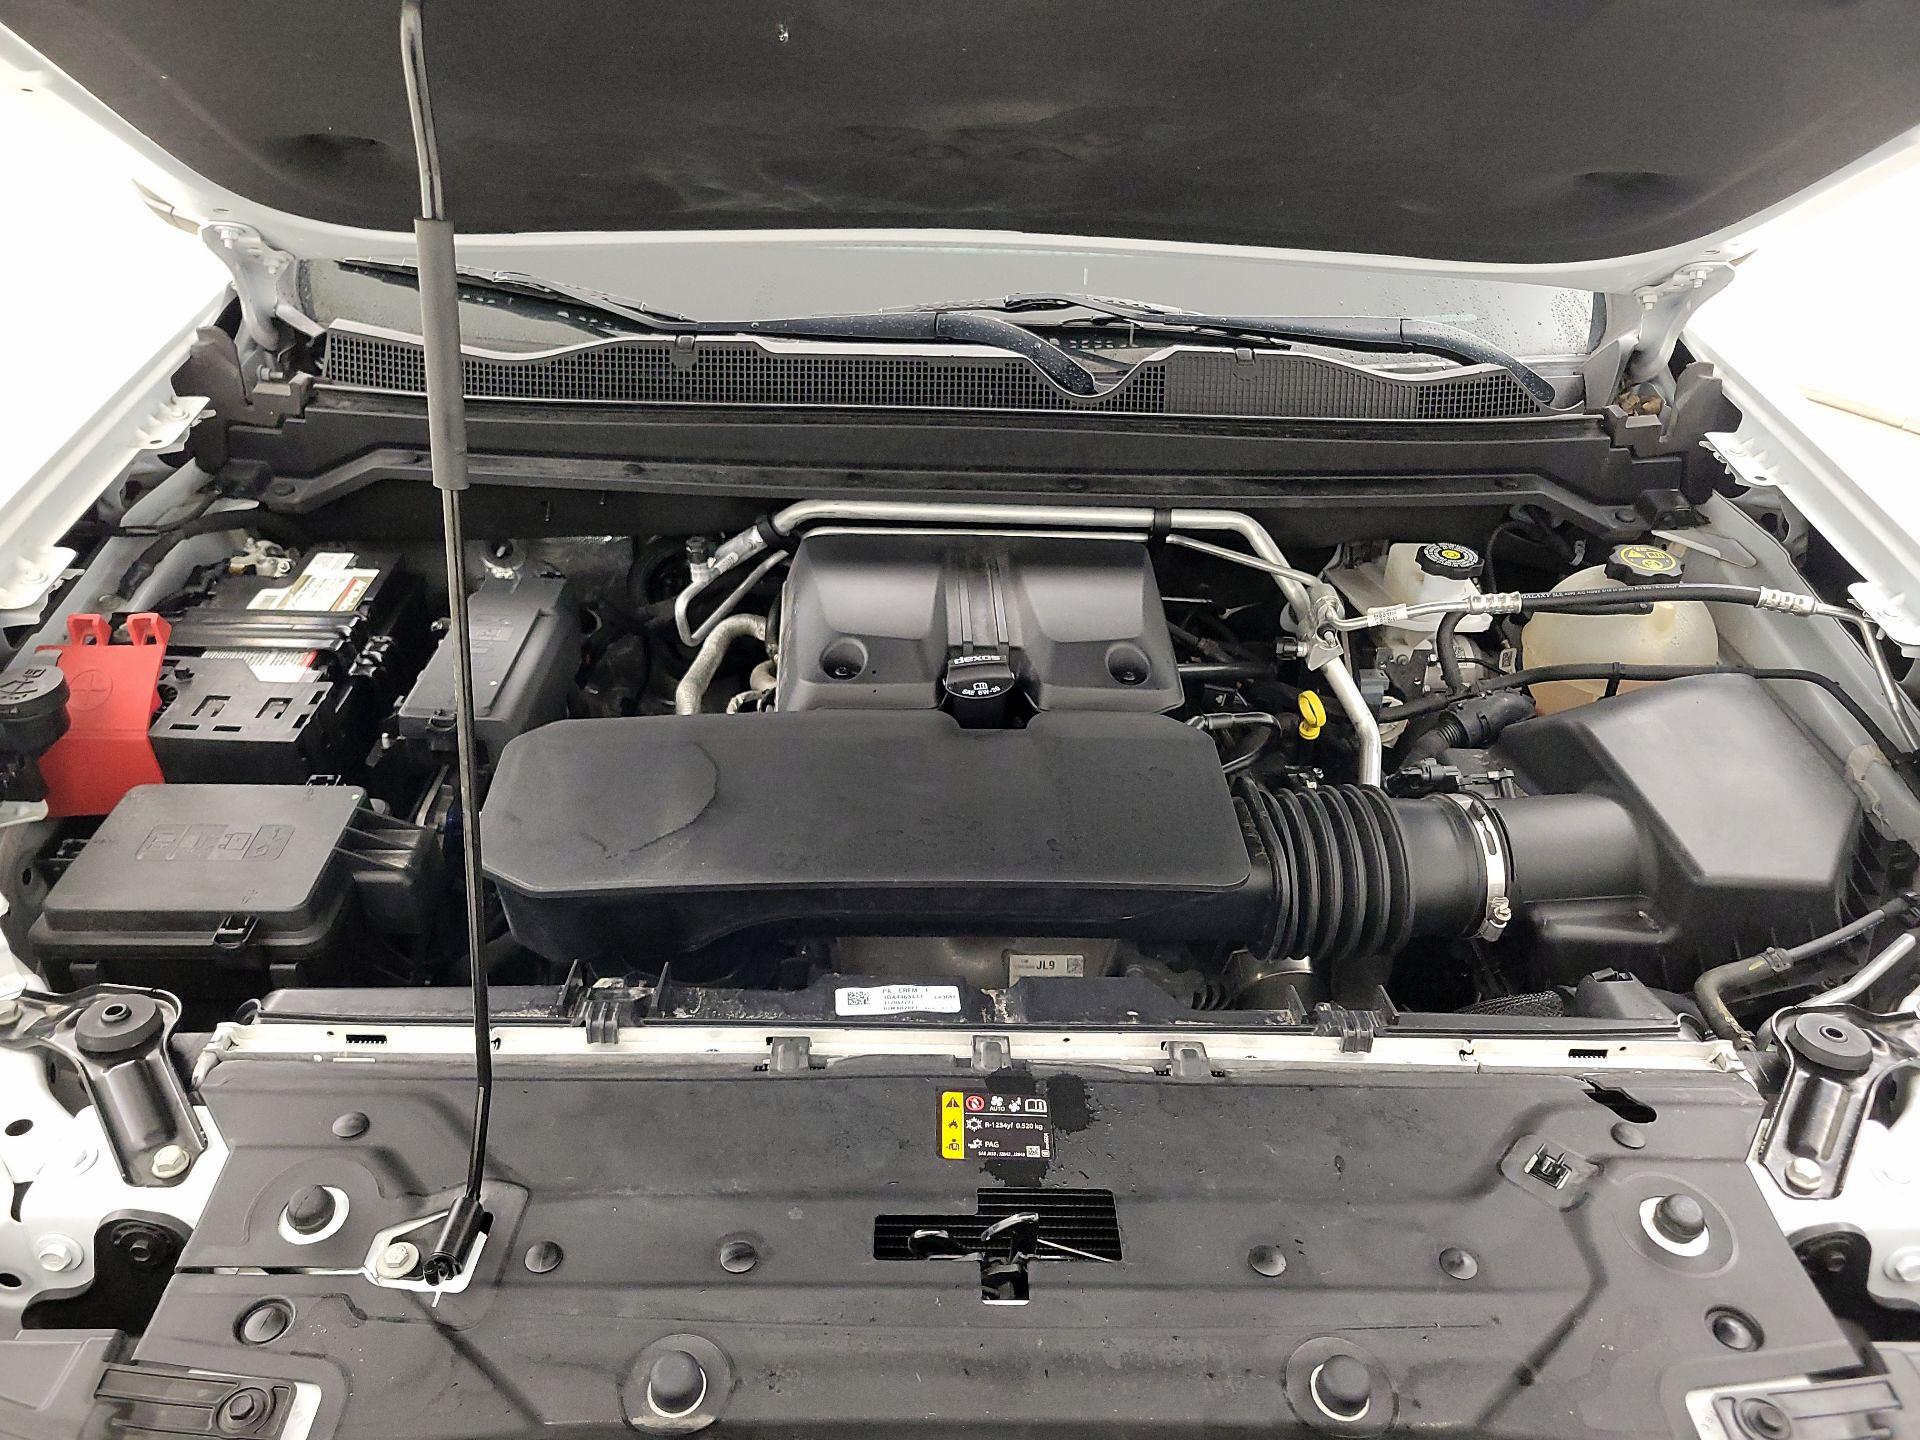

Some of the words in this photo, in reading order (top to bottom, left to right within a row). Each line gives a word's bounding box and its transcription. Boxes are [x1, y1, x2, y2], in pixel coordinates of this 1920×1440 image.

[953, 655, 1001, 664] dexos
[1036, 960, 1055, 970] JL9
[984, 1121, 1013, 1130] R-1234yf
[1035, 1122, 1043, 1131] kg
